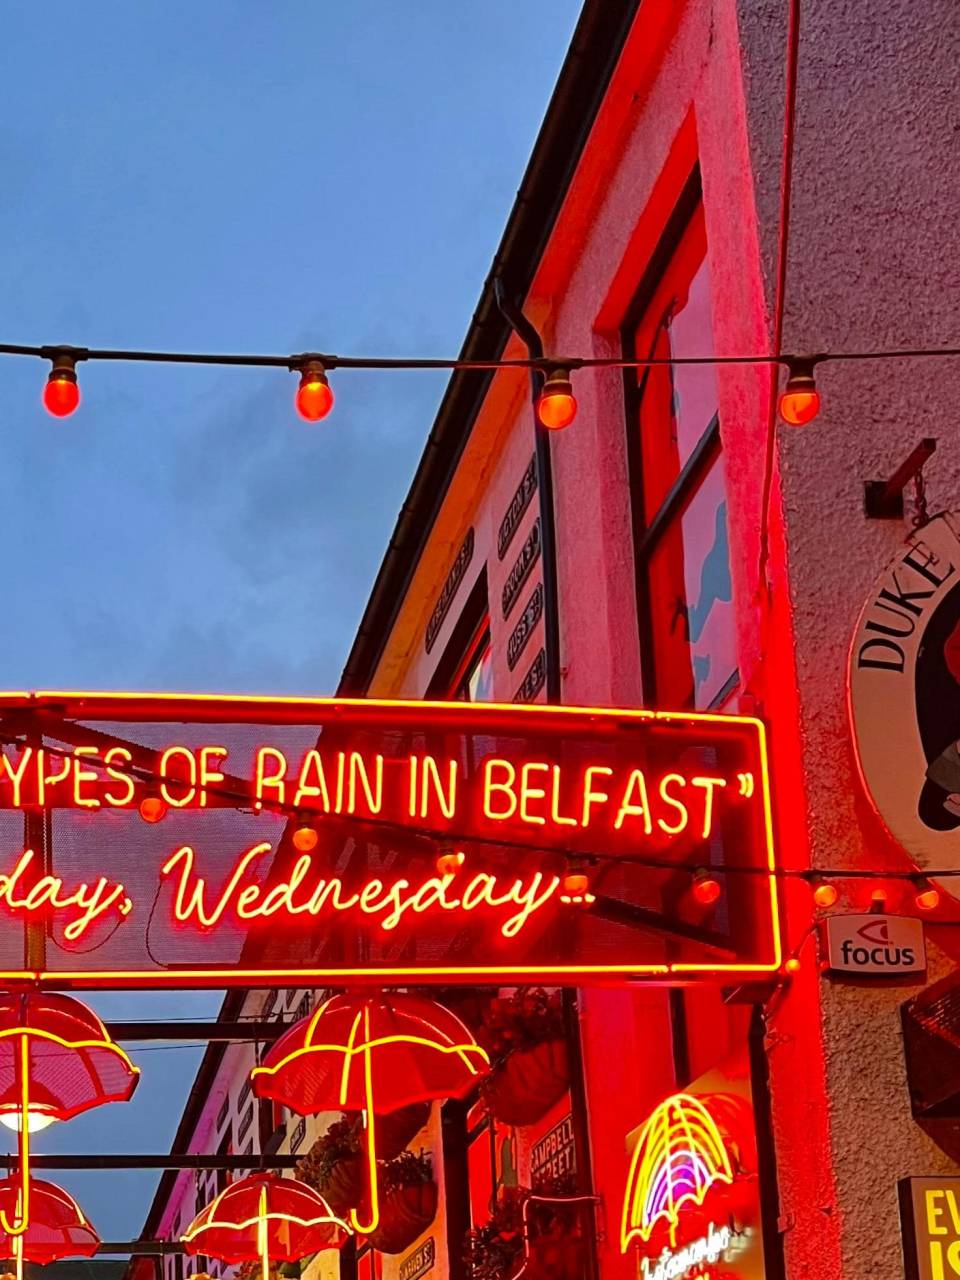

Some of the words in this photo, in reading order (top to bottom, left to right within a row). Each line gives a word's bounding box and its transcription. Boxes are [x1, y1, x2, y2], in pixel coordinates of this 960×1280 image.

[858, 541, 955, 674] DUKE
[159, 746, 228, 808] OF
[253, 747, 383, 815] RAIN
[408, 755, 458, 819] IN
[841, 939, 915, 967] focus
